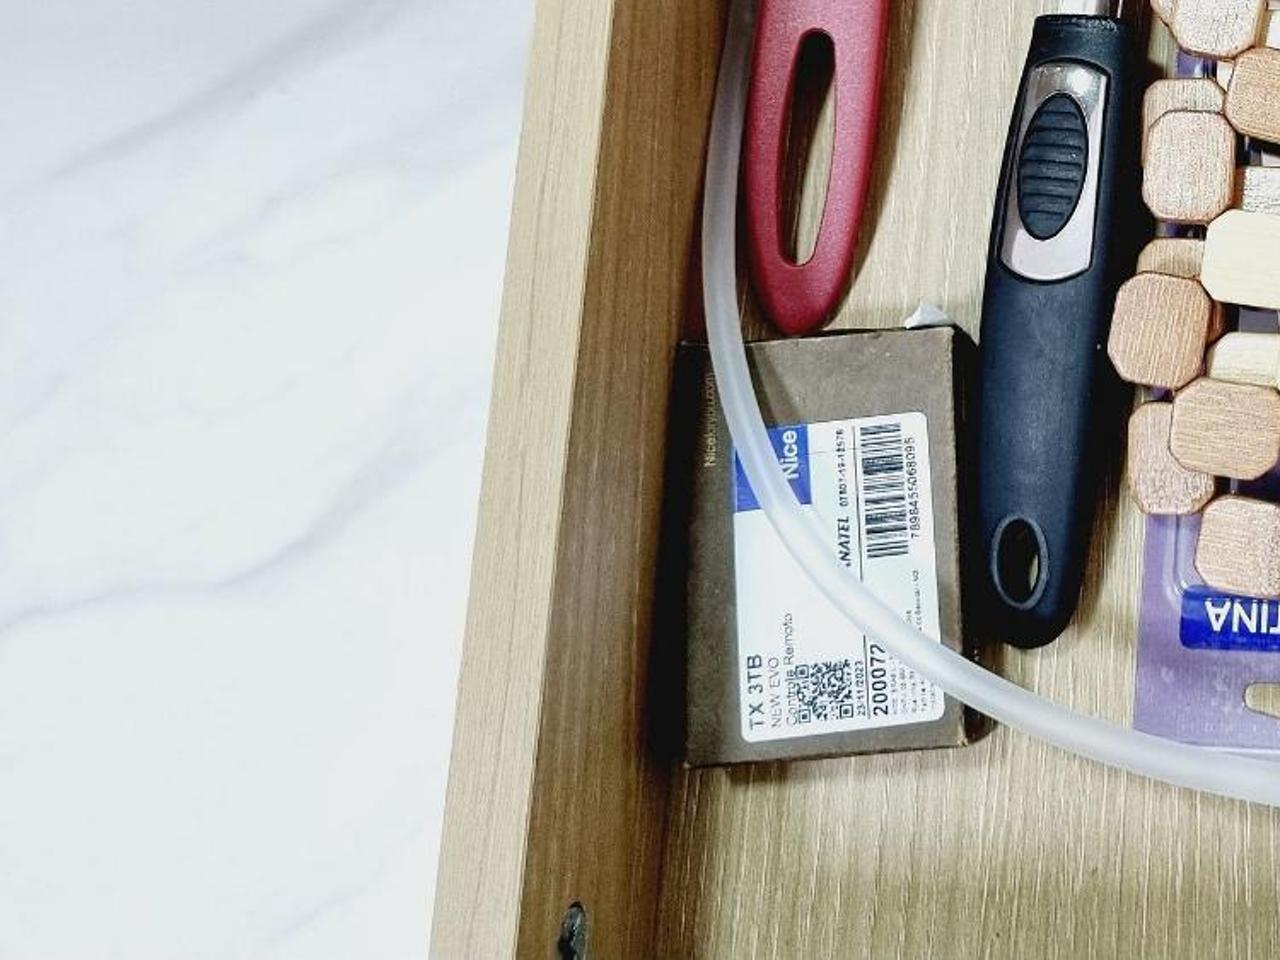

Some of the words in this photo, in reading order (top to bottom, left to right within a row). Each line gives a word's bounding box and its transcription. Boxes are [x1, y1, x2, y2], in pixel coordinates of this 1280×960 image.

[779, 430, 800, 480] Nice
[782, 612, 795, 666] Remoto
[746, 653, 764, 695] 3TB
[767, 656, 781, 688] EVO
[748, 701, 765, 730] TX
[770, 693, 783, 728] NEW
[785, 669, 798, 726] Controle
